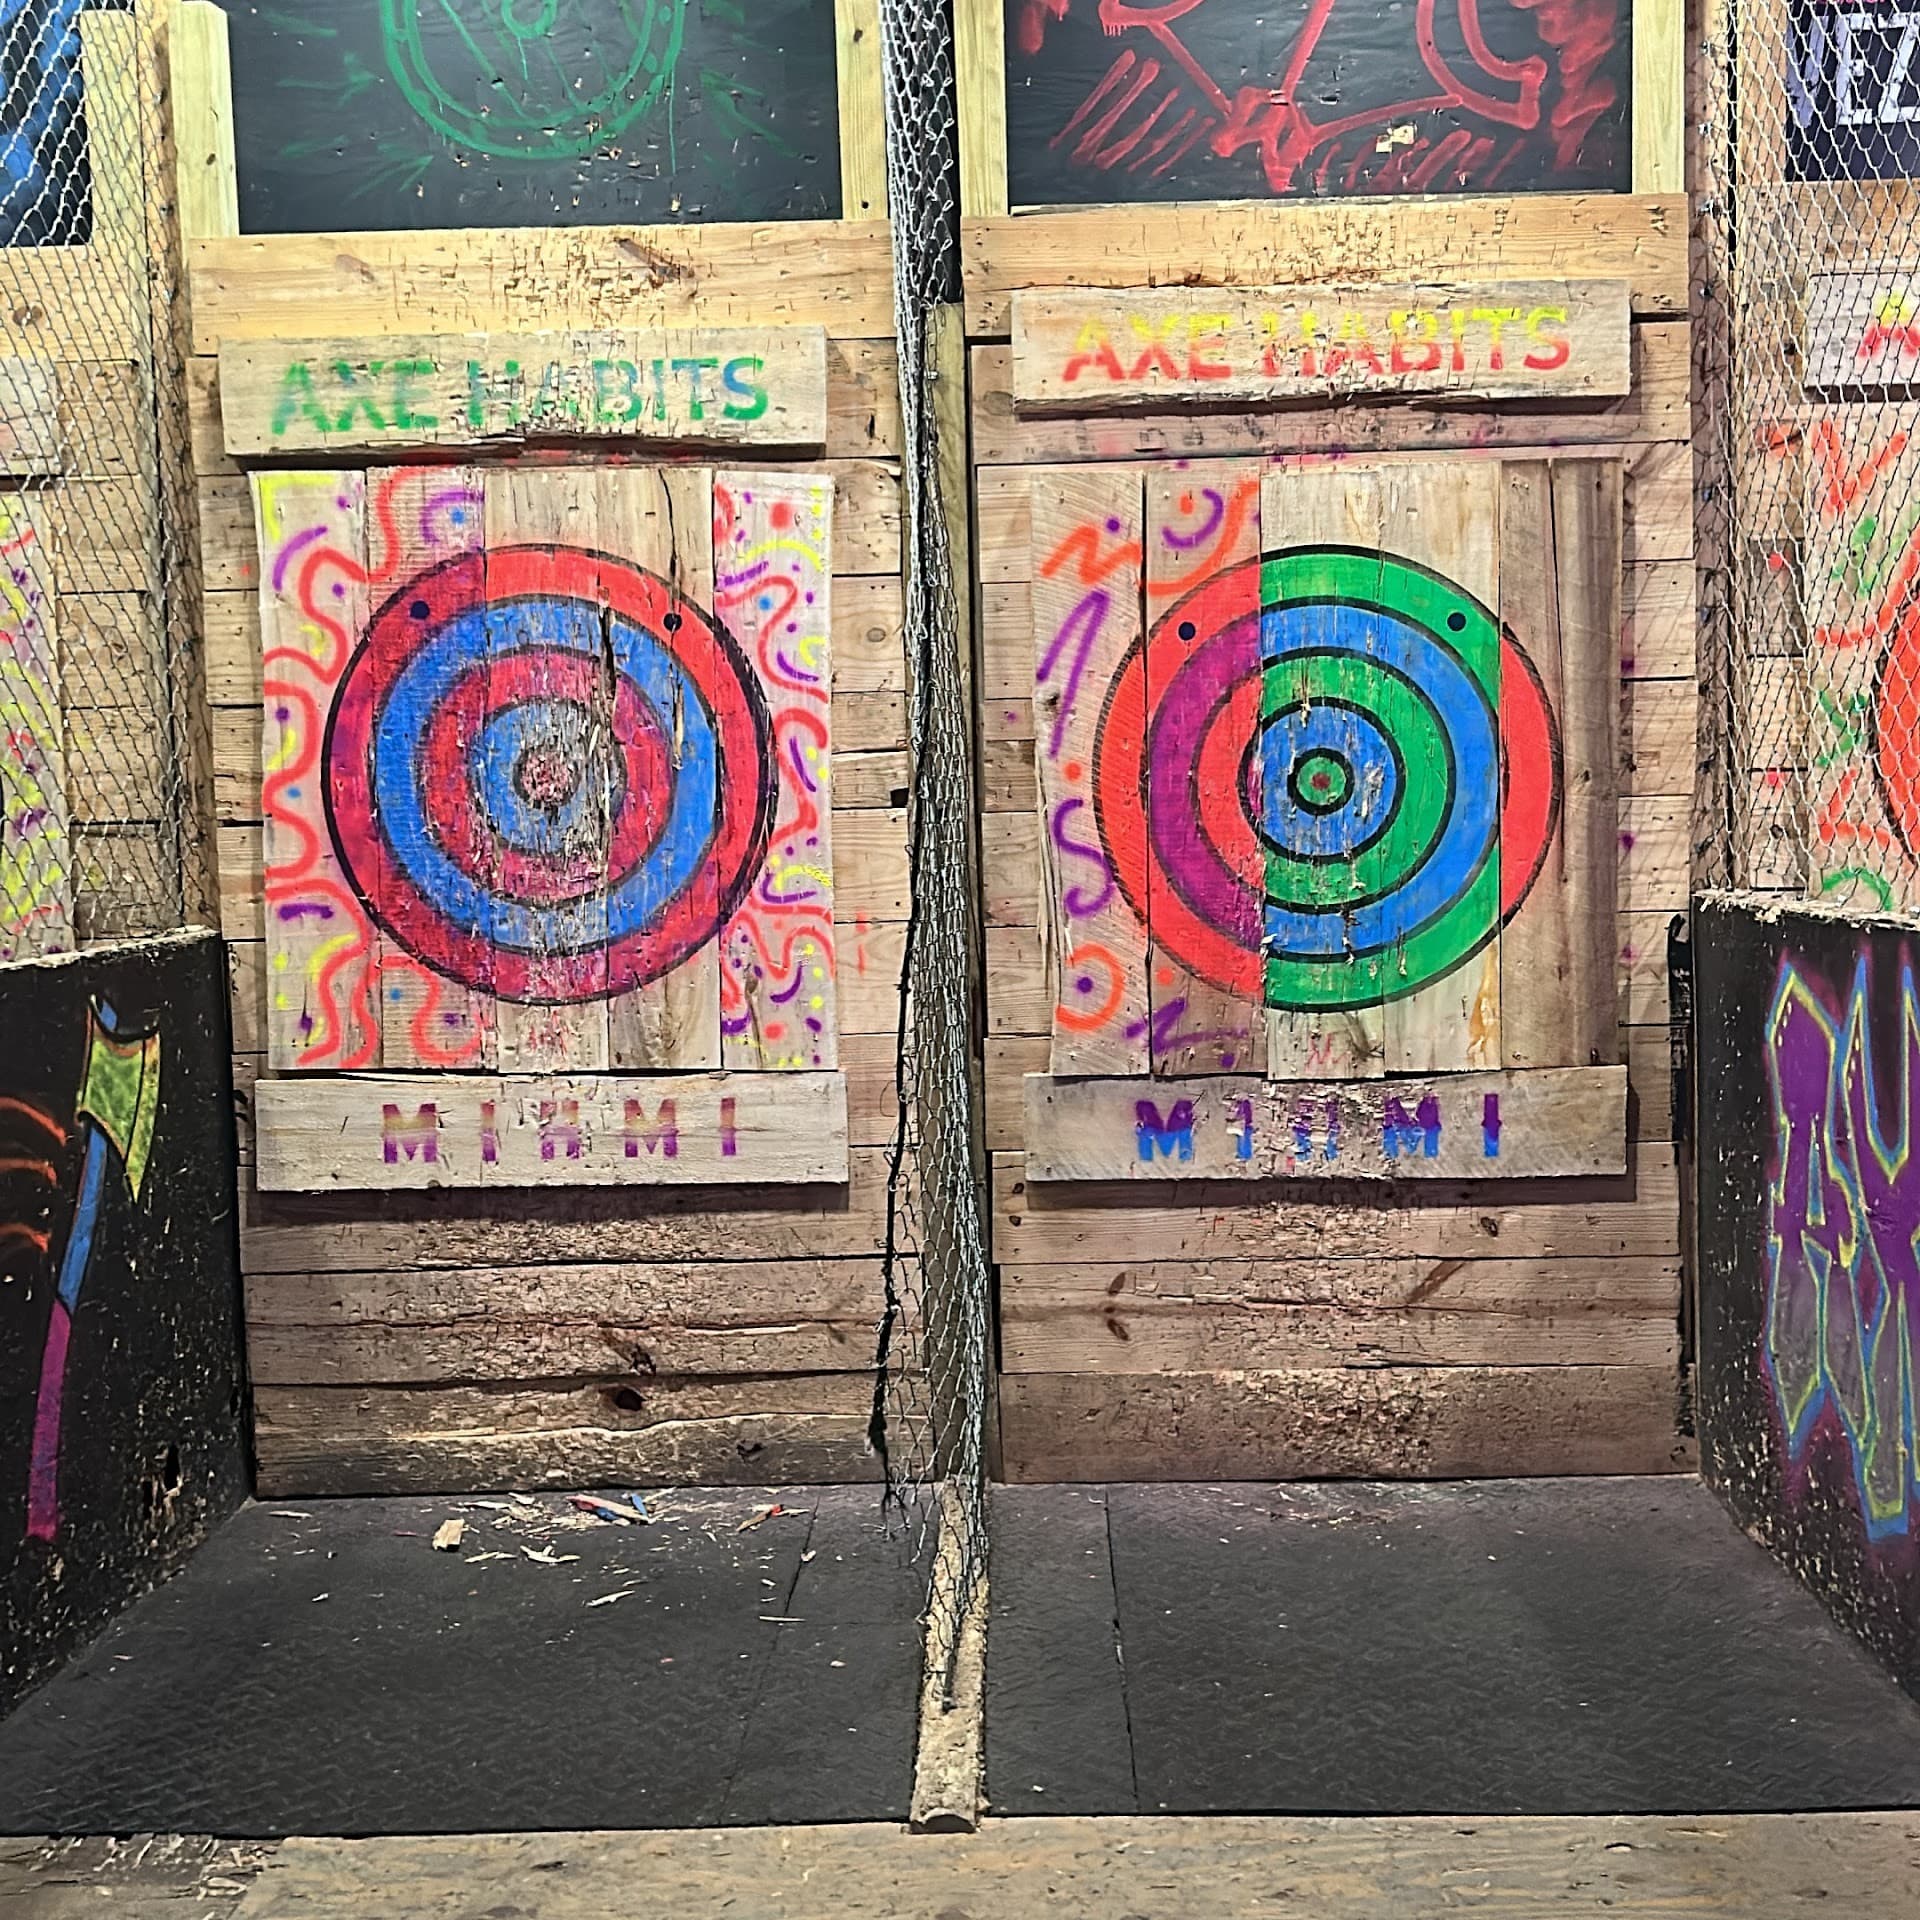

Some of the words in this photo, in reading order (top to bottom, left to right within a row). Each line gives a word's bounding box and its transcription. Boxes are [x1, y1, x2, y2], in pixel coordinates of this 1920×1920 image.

[1062, 312, 1232, 382] AXE
[1261, 306, 1571, 379] HABITS
[270, 359, 440, 435] AXE
[465, 356, 770, 428] HABITS
[382, 1096, 738, 1164] MIAMI
